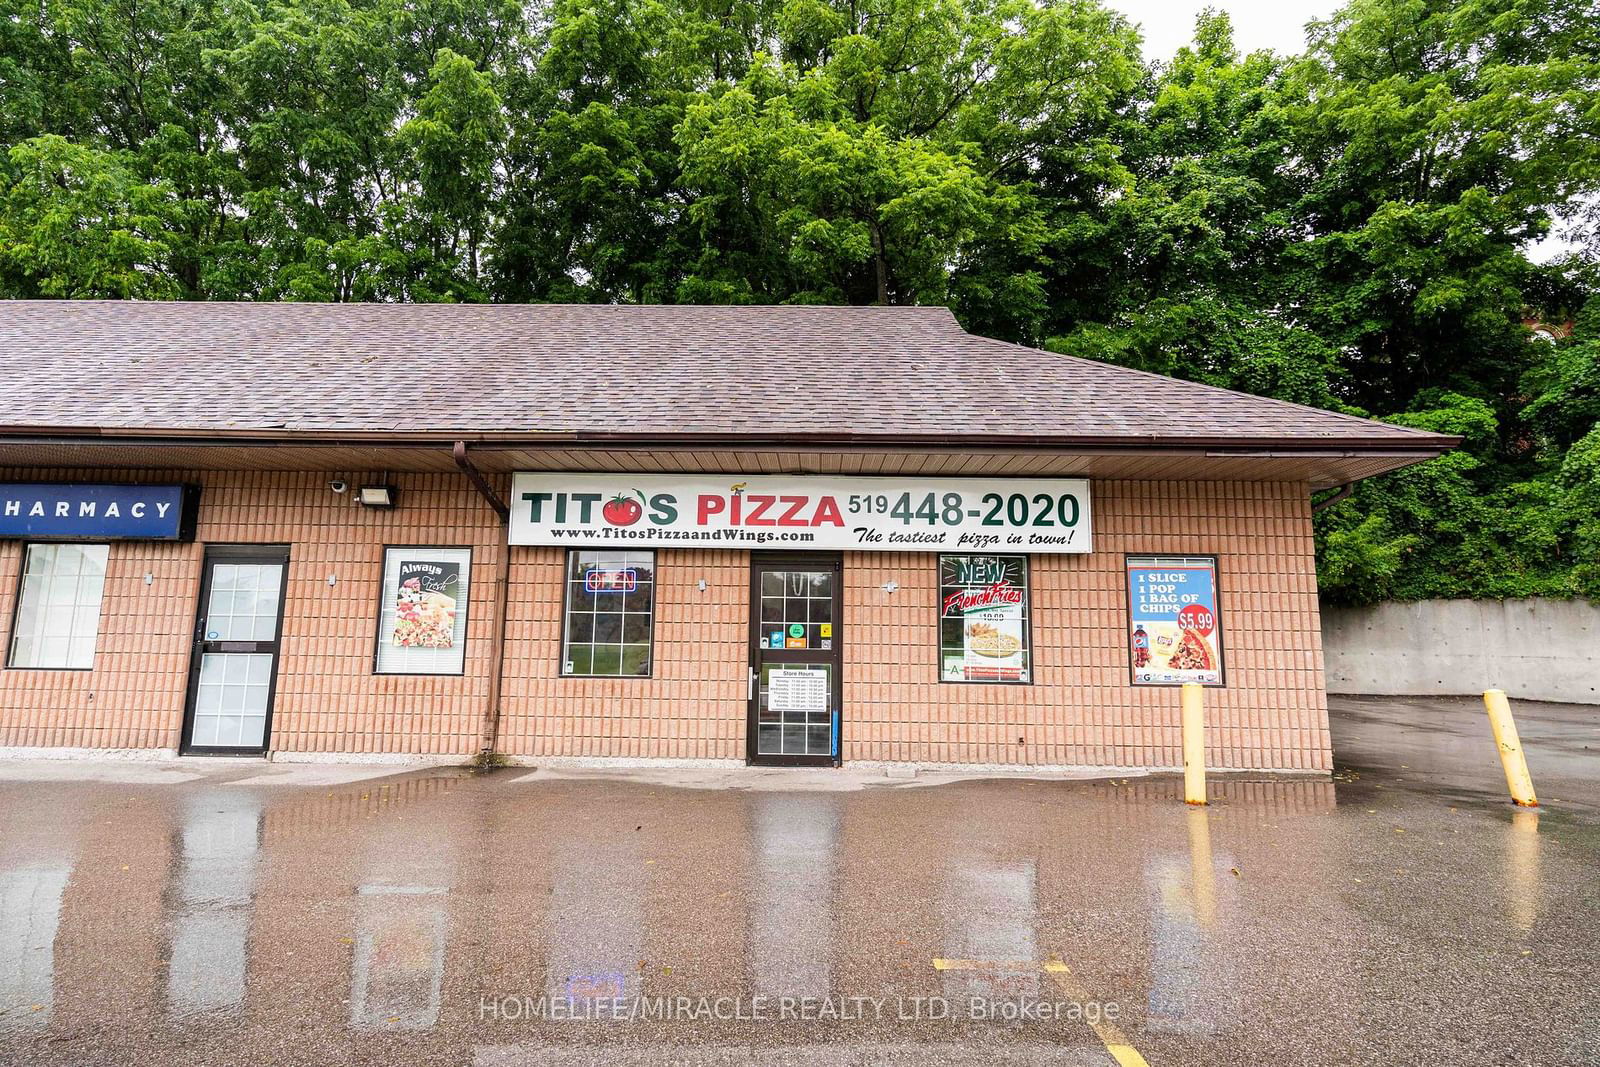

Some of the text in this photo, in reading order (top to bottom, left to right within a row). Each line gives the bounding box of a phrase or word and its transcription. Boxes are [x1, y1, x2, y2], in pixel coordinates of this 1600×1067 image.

[697, 494, 845, 527] PIZZA
[848, 492, 1080, 527] 519 448-2020
[550, 528, 815, 543] www.TitosPizzaandWings.com
[853, 527, 1076, 549] The tastiest pizza in town!
[401, 563, 443, 576] Always
[957, 562, 1006, 584] NEW
[1138, 573, 1187, 582] 1 SLICE
[422, 573, 458, 591] Fresh
[588, 573, 633, 589] OPEN
[1139, 584, 1176, 593] 1 POP
[943, 579, 1022, 617] French Fries
[1140, 594, 1200, 603] 1 BAG OF
[1140, 604, 1181, 613] CHIPS
[1179, 613, 1213, 630] $5.99
